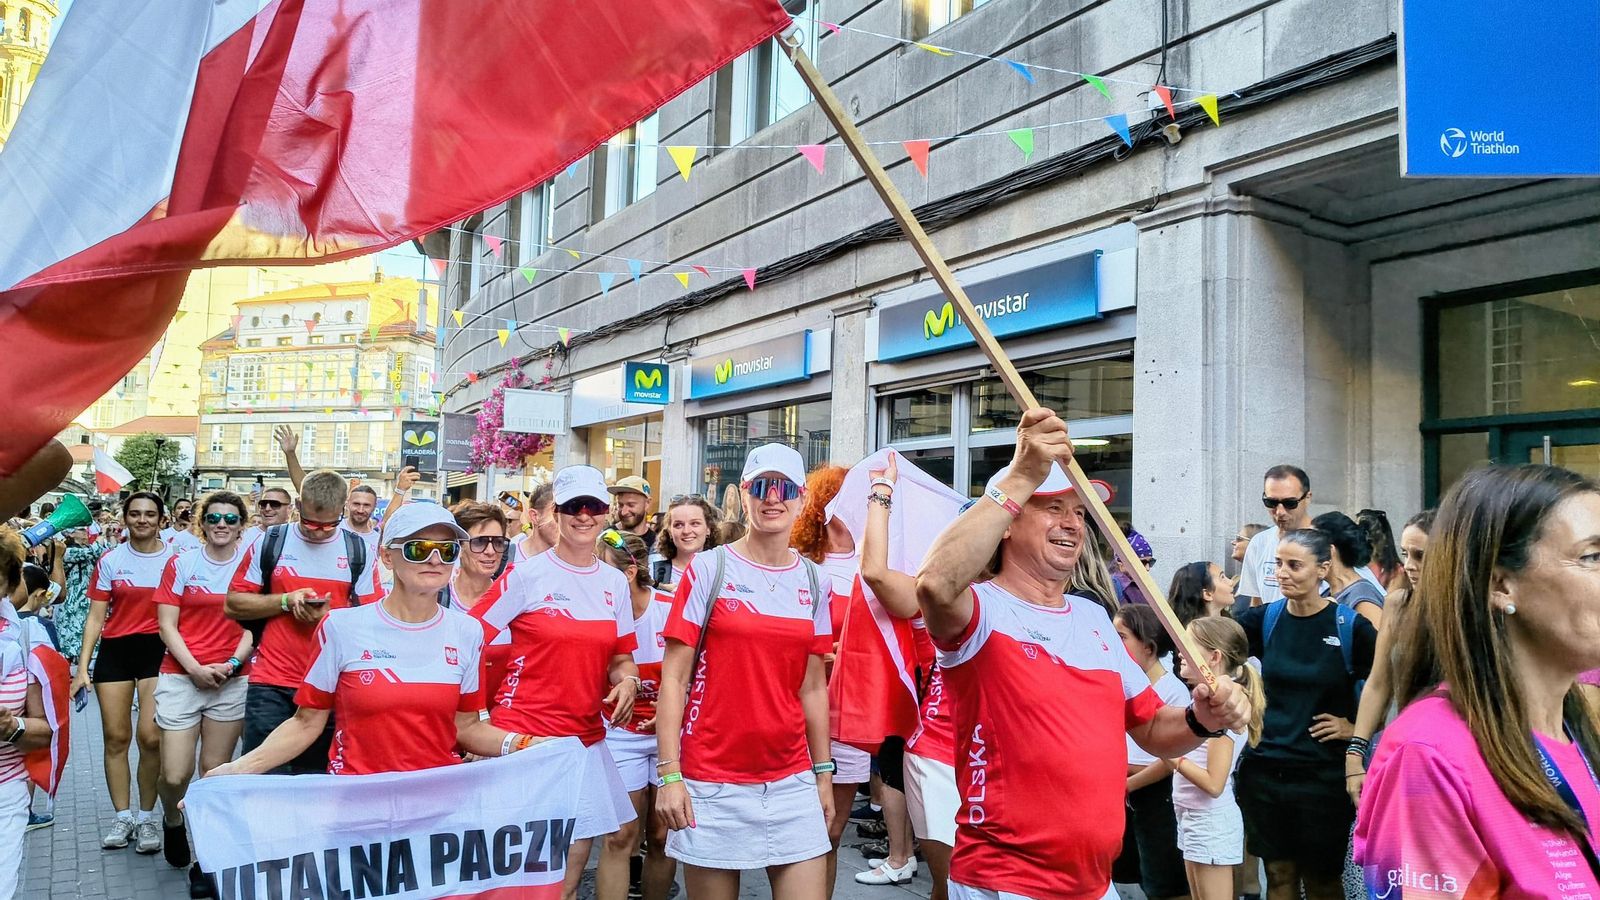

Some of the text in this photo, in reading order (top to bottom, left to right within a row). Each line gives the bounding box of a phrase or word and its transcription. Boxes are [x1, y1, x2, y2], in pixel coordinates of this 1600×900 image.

[1470, 130, 1504, 142] World
[1470, 142, 1520, 154] Triathlon
[958, 292, 1030, 326] ovistar
[733, 355, 774, 377] movistar
[633, 391, 662, 399] movistar
[402, 447, 437, 456] HELADERÍA
[499, 655, 526, 709] OLSKA
[686, 649, 707, 735] POLSKA
[926, 661, 944, 720] OLSKA
[967, 724, 988, 828] OLSKA
[430, 817, 577, 888] PACZK
[1375, 863, 1458, 899] galicia
